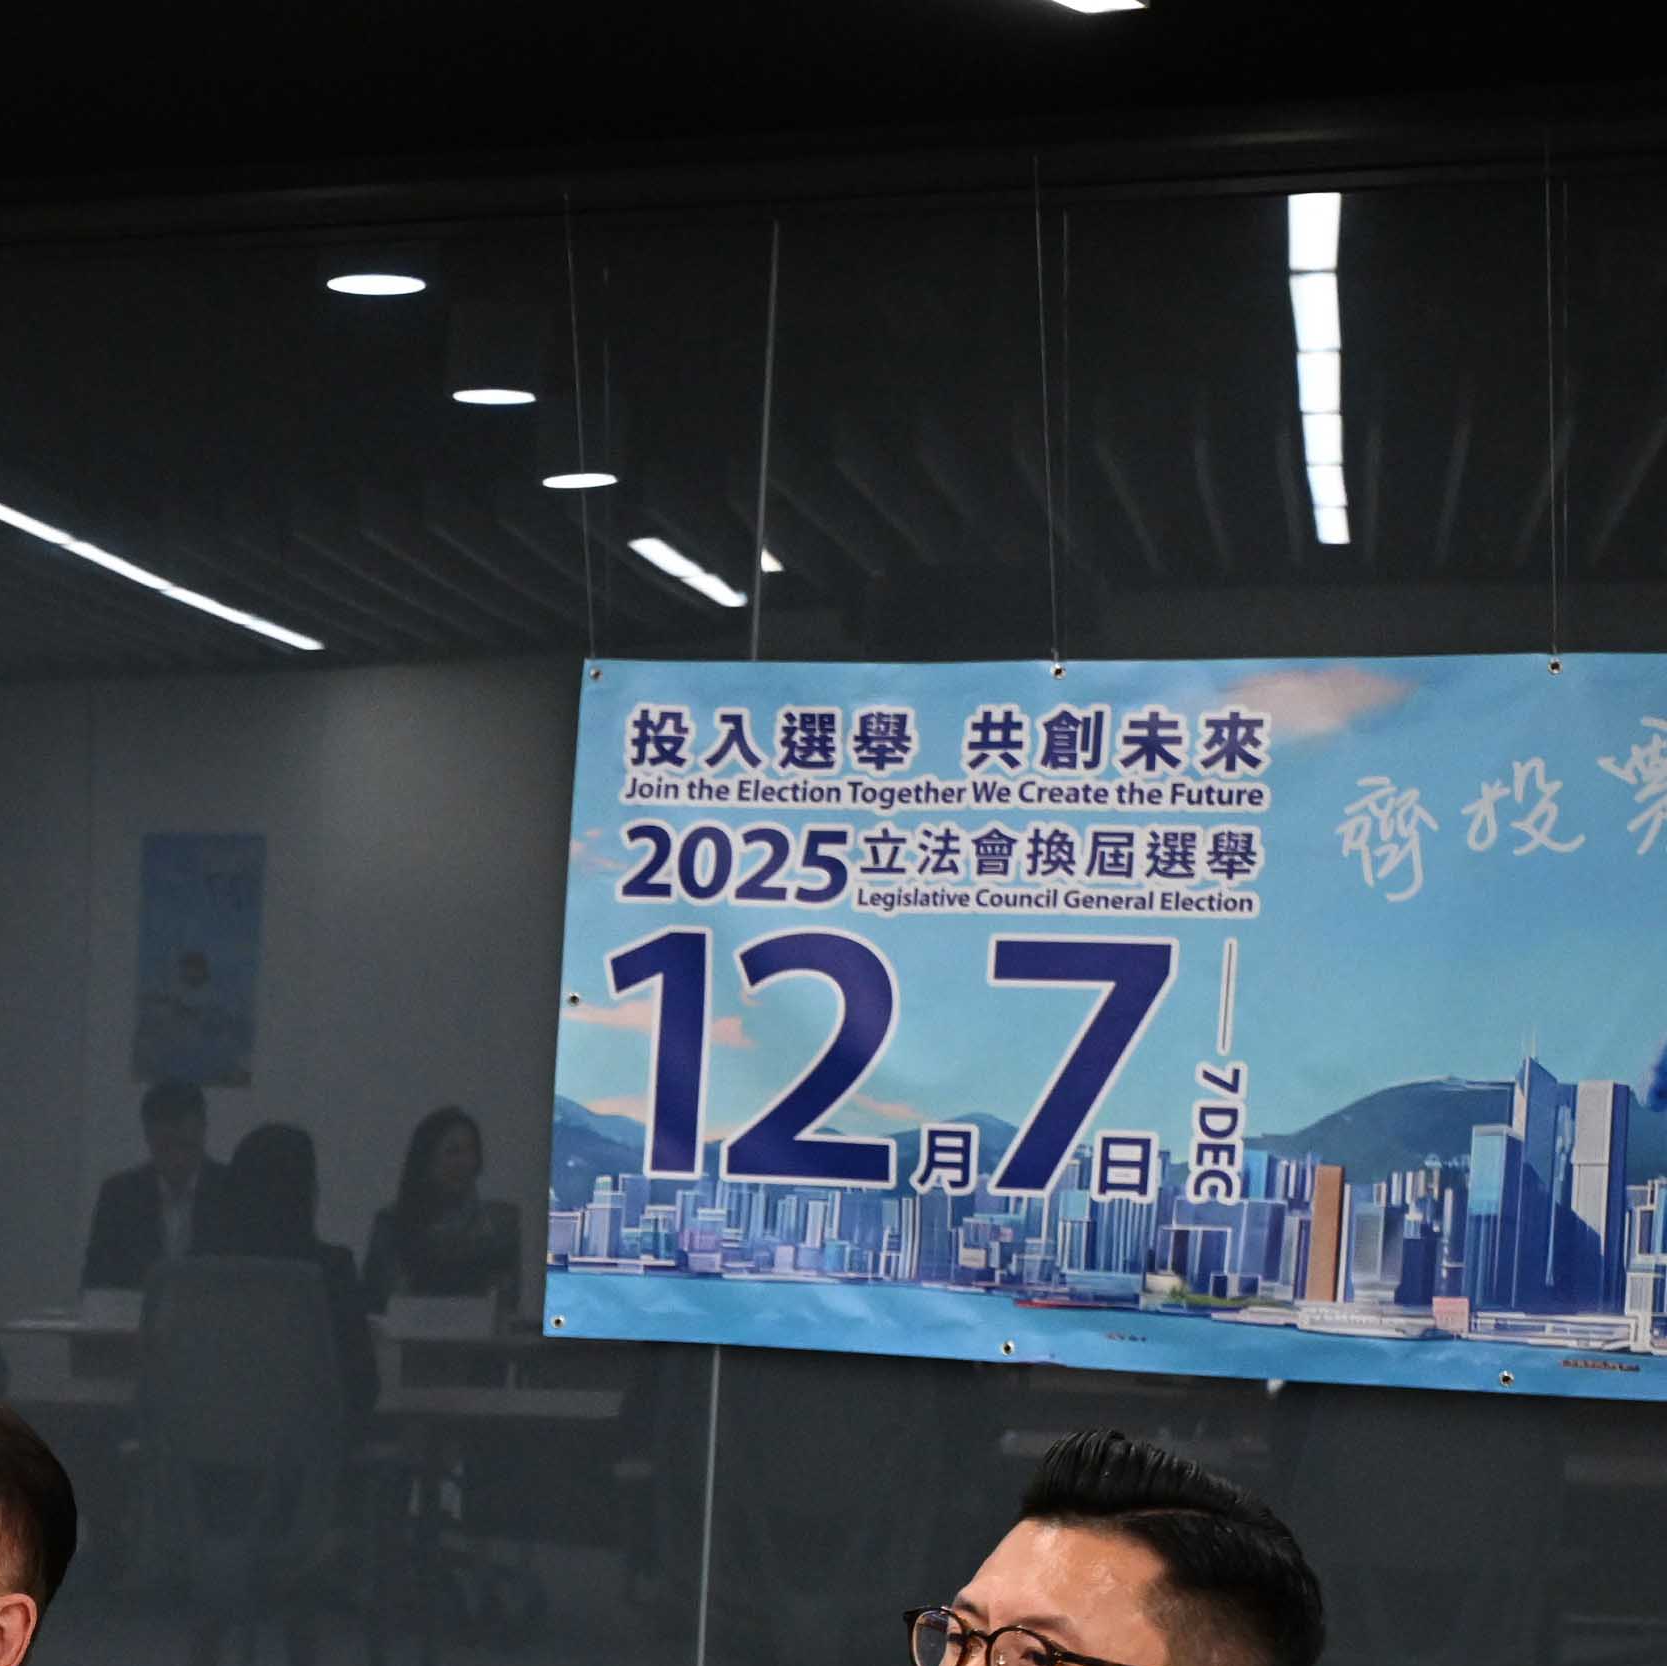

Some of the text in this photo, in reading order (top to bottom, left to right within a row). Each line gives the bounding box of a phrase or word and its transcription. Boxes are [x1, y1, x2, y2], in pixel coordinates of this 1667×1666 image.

[631, 709, 1265, 772] 投入選舉 共創未來
[626, 776, 1265, 809] Join the Election Together We Create the Future
[622, 825, 849, 903] 2025
[860, 828, 1258, 880] 立法會換屆選舉
[857, 888, 1254, 912] Legislative Council General Election
[1194, 1068, 1241, 1199] 7 DEC
